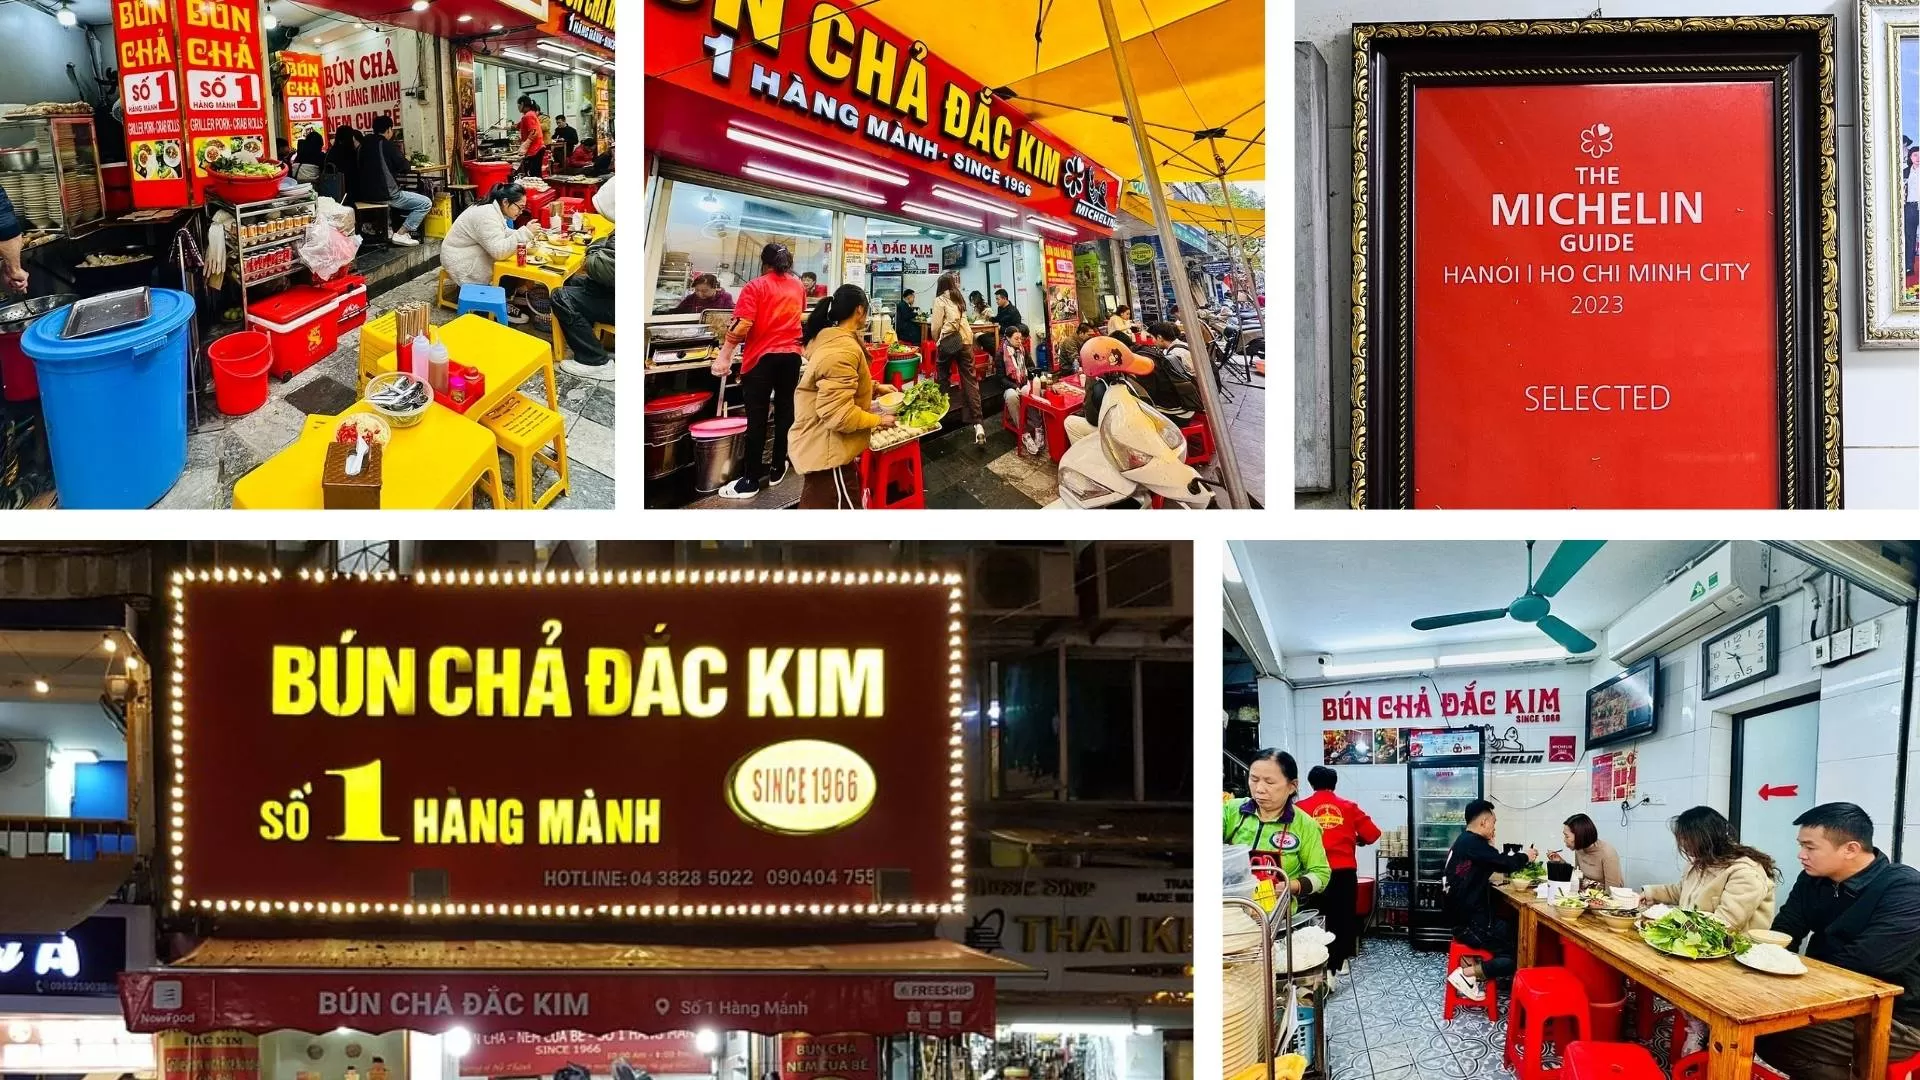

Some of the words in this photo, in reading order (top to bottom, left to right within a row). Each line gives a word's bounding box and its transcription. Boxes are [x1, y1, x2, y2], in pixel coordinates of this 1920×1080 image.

[121, 29, 171, 68] CHẢ
[187, 36, 255, 69] CHẢ
[324, 56, 354, 88] BÚN
[360, 38, 398, 80] CHẢ
[132, 76, 150, 101] SỐ
[156, 72, 176, 109] 1
[200, 75, 226, 98] SỐ
[235, 75, 258, 108] 1
[287, 79, 320, 96] CHẢ
[326, 87, 336, 110] SỐ
[338, 92, 342, 108] 1
[345, 86, 368, 108] HÀNG
[371, 80, 400, 104] MÀNH
[809, 3, 928, 123] CHẢ
[944, 83, 1013, 160] ĐẮC
[1017, 129, 1061, 186] KIM
[293, 99, 306, 112] SỐ
[310, 98, 321, 118] 1
[704, 34, 734, 79] 1
[750, 63, 860, 130] HÀNG
[866, 114, 939, 160] MÀNH
[953, 151, 1000, 184] SINCE
[1003, 175, 1032, 197] 1966
[1574, 166, 1620, 185] THE
[1075, 203, 1118, 228] MICHELIN
[1491, 191, 1703, 226] MICHELIN
[883, 240, 907, 254] ĐẮC
[911, 244, 933, 254] KIM
[1559, 233, 1635, 252] GUIDE
[1541, 264, 1575, 283] HO
[1583, 263, 1620, 283] CHI
[1629, 263, 1691, 282] MINH
[1700, 262, 1751, 281] CITY
[1571, 296, 1624, 314] 2023
[1525, 384, 1671, 412] SELECTED
[272, 629, 415, 716] BÚN
[429, 619, 572, 717] CHẢ
[585, 624, 728, 718] ĐẮC
[747, 647, 885, 718] KIM
[1322, 690, 1372, 721] BÚN
[1378, 686, 1433, 719] CHẢ
[1441, 680, 1496, 717] ĐẮC
[1505, 687, 1561, 714] KIM
[1515, 714, 1540, 723] SINCE
[752, 767, 807, 804] SINCE
[811, 767, 858, 804] 1966
[260, 782, 312, 840] SỐ
[325, 759, 401, 841] 1
[414, 786, 524, 844] HÀNG
[539, 788, 661, 844] MÀNH
[657, 869, 701, 886] 3828
[708, 869, 753, 886] 5022
[766, 868, 838, 886] 090404
[1014, 914, 1133, 954] THAI
[319, 985, 381, 1016] BÚN
[390, 985, 454, 1016] CHẢ
[463, 987, 524, 1016] ĐẮC
[533, 992, 589, 1016] KIM
[911, 985, 973, 996] FREESHIP
[141, 1012, 195, 1024] NowFood
[681, 1000, 700, 1014] Số
[707, 1002, 713, 1014] 1
[720, 1001, 760, 1015] Hàng
[765, 1001, 808, 1015] Mành
[535, 1045, 570, 1056] SINCE
[574, 1044, 601, 1055] 1966
